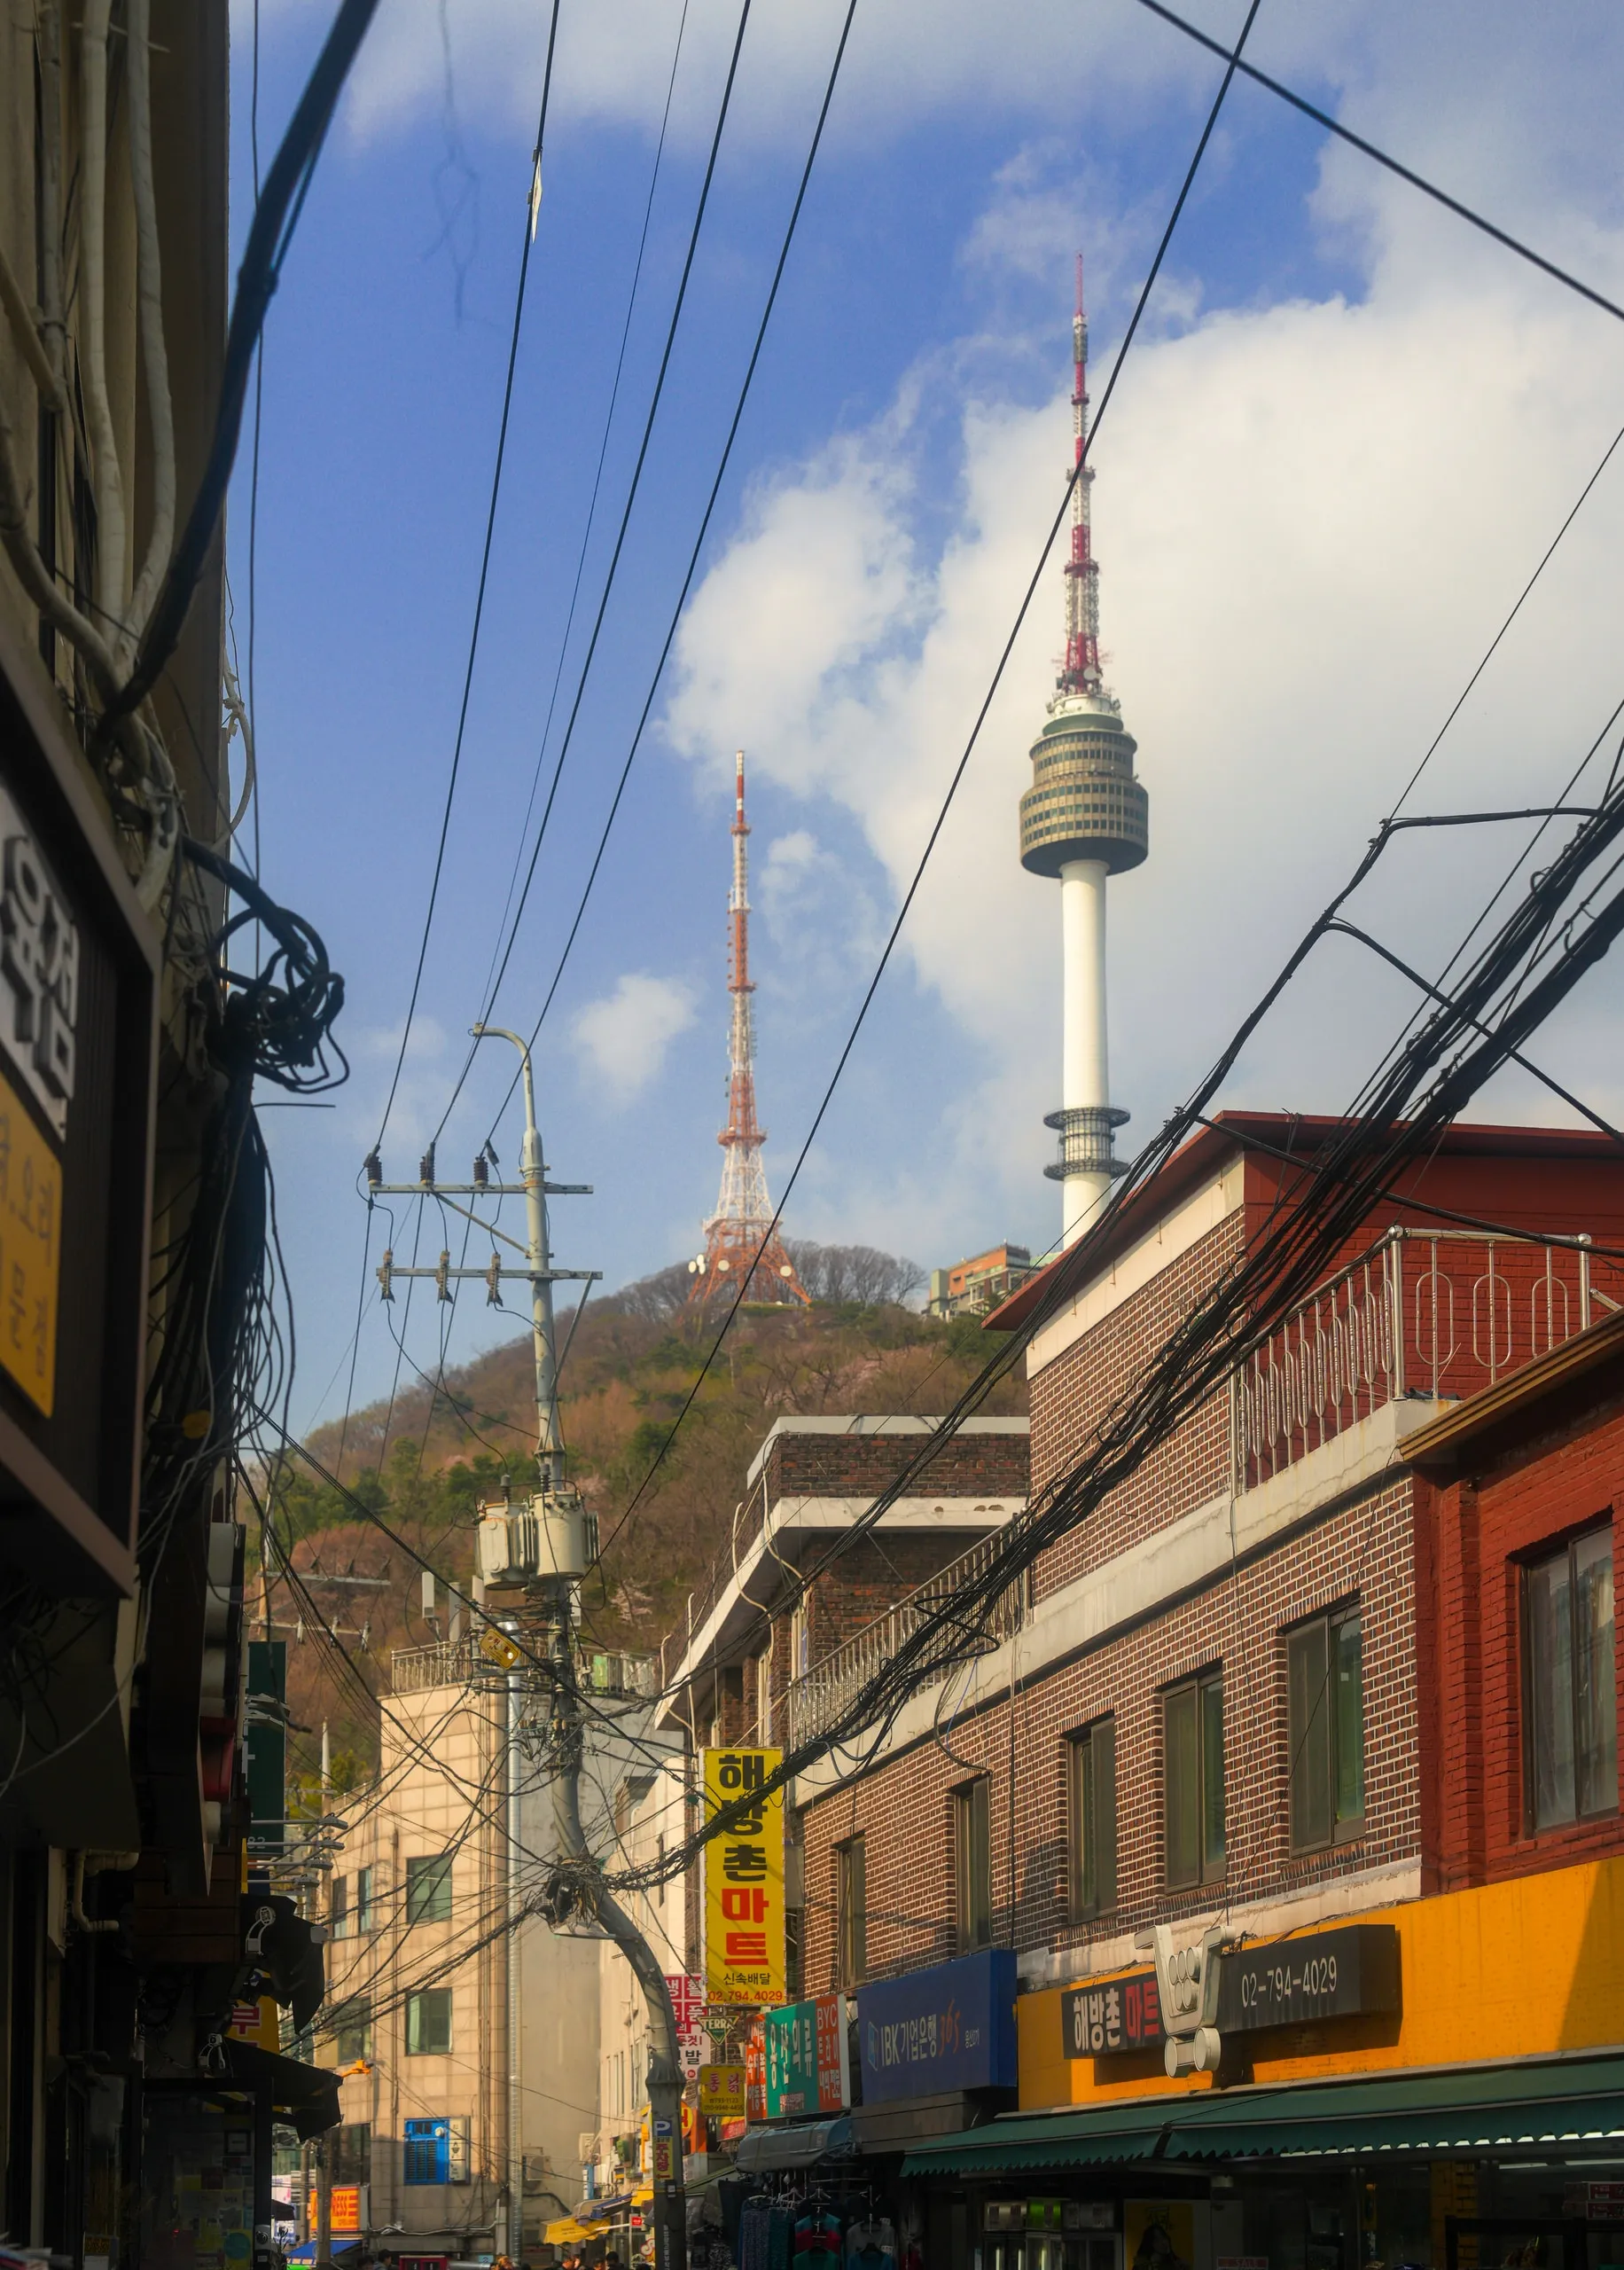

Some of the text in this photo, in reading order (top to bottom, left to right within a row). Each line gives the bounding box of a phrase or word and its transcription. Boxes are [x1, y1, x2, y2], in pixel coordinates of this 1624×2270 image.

[723, 1972, 771, 1985] 신속배달
[1241, 1955, 1337, 2008] 02-794-4029
[708, 1990, 783, 2002] 02.794.4029
[701, 2017, 735, 2030] TERRA
[816, 2003, 838, 2031] BYC
[1074, 1979, 1159, 2051] 해방촌 마트
